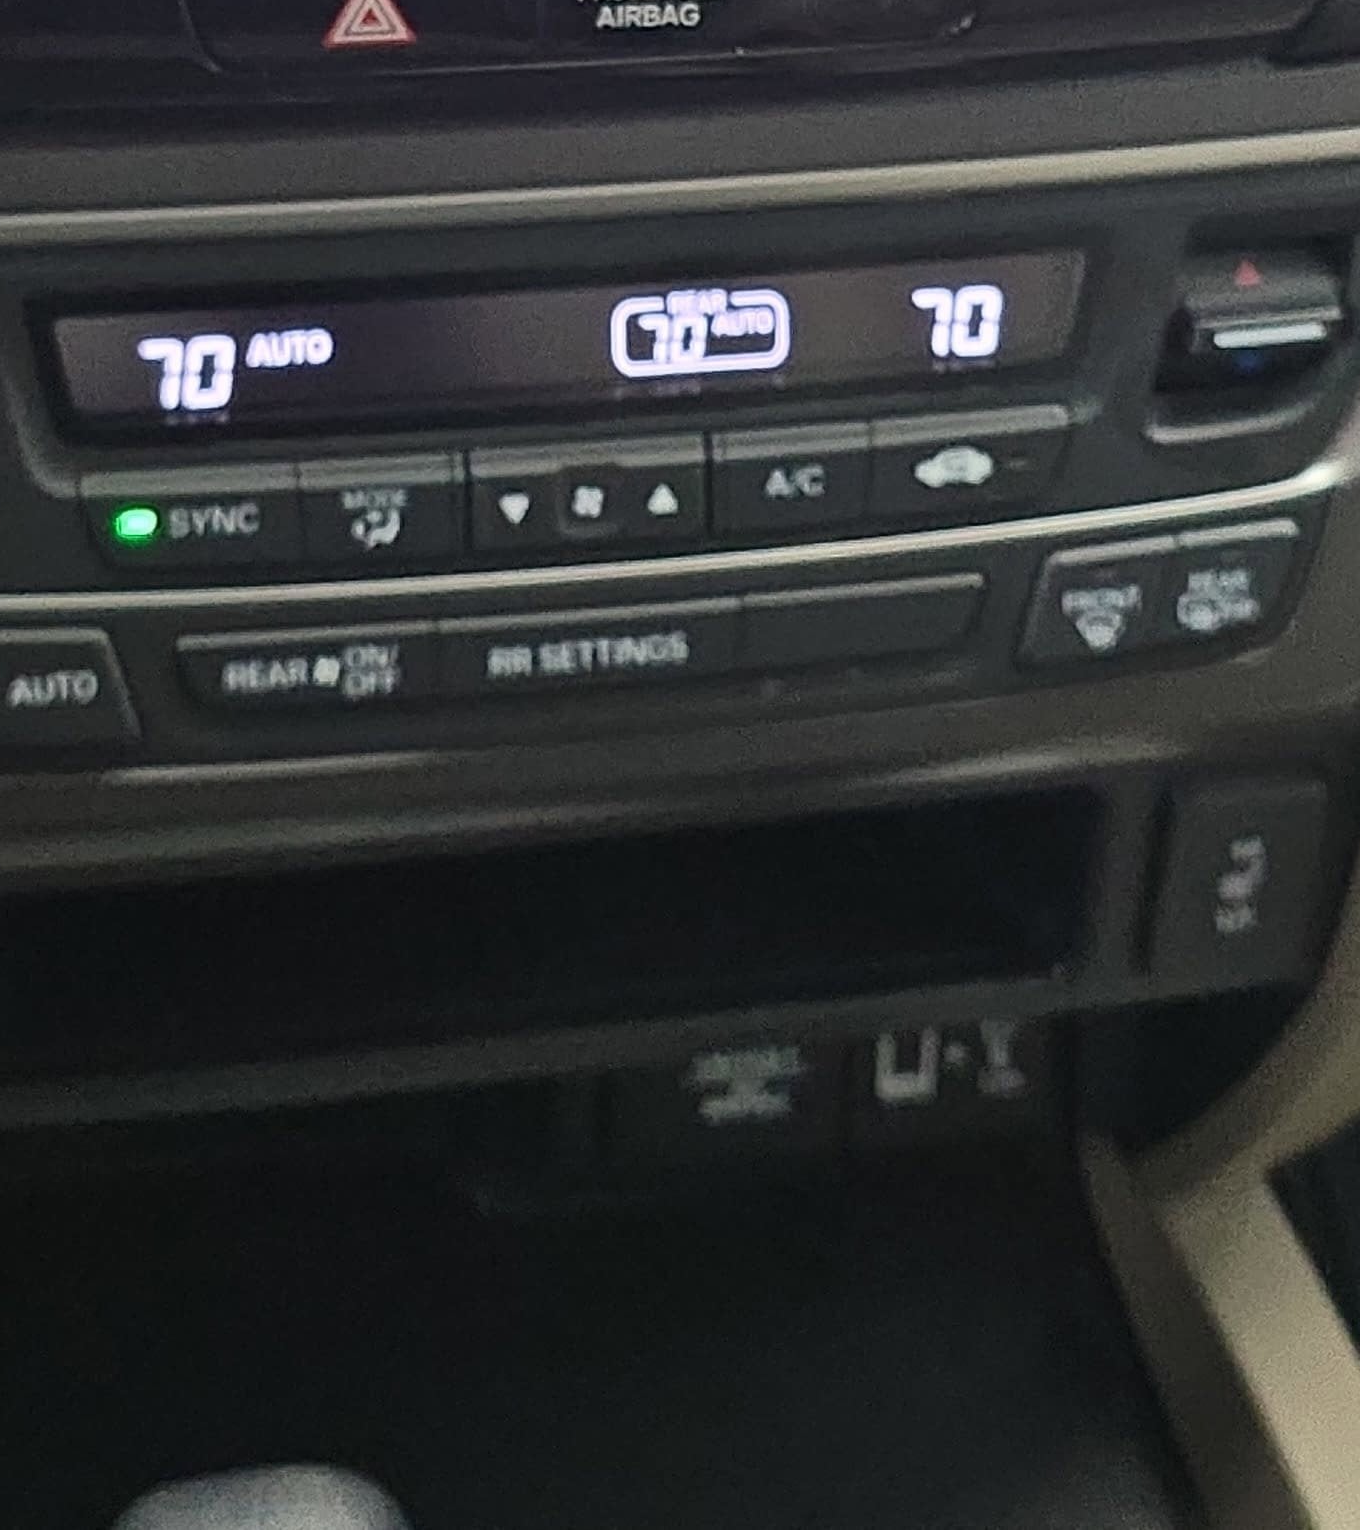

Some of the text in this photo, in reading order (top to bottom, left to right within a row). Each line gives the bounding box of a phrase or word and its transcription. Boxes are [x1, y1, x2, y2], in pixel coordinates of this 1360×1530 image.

[596, 4, 700, 29] AIRBAG
[638, 314, 708, 363] 70
[710, 308, 775, 337] AUTO
[911, 284, 1004, 358] 70
[246, 328, 334, 368] AUTO
[138, 335, 236, 411] 70
[168, 503, 260, 539] SYNC
[7, 670, 98, 707] AUTO
